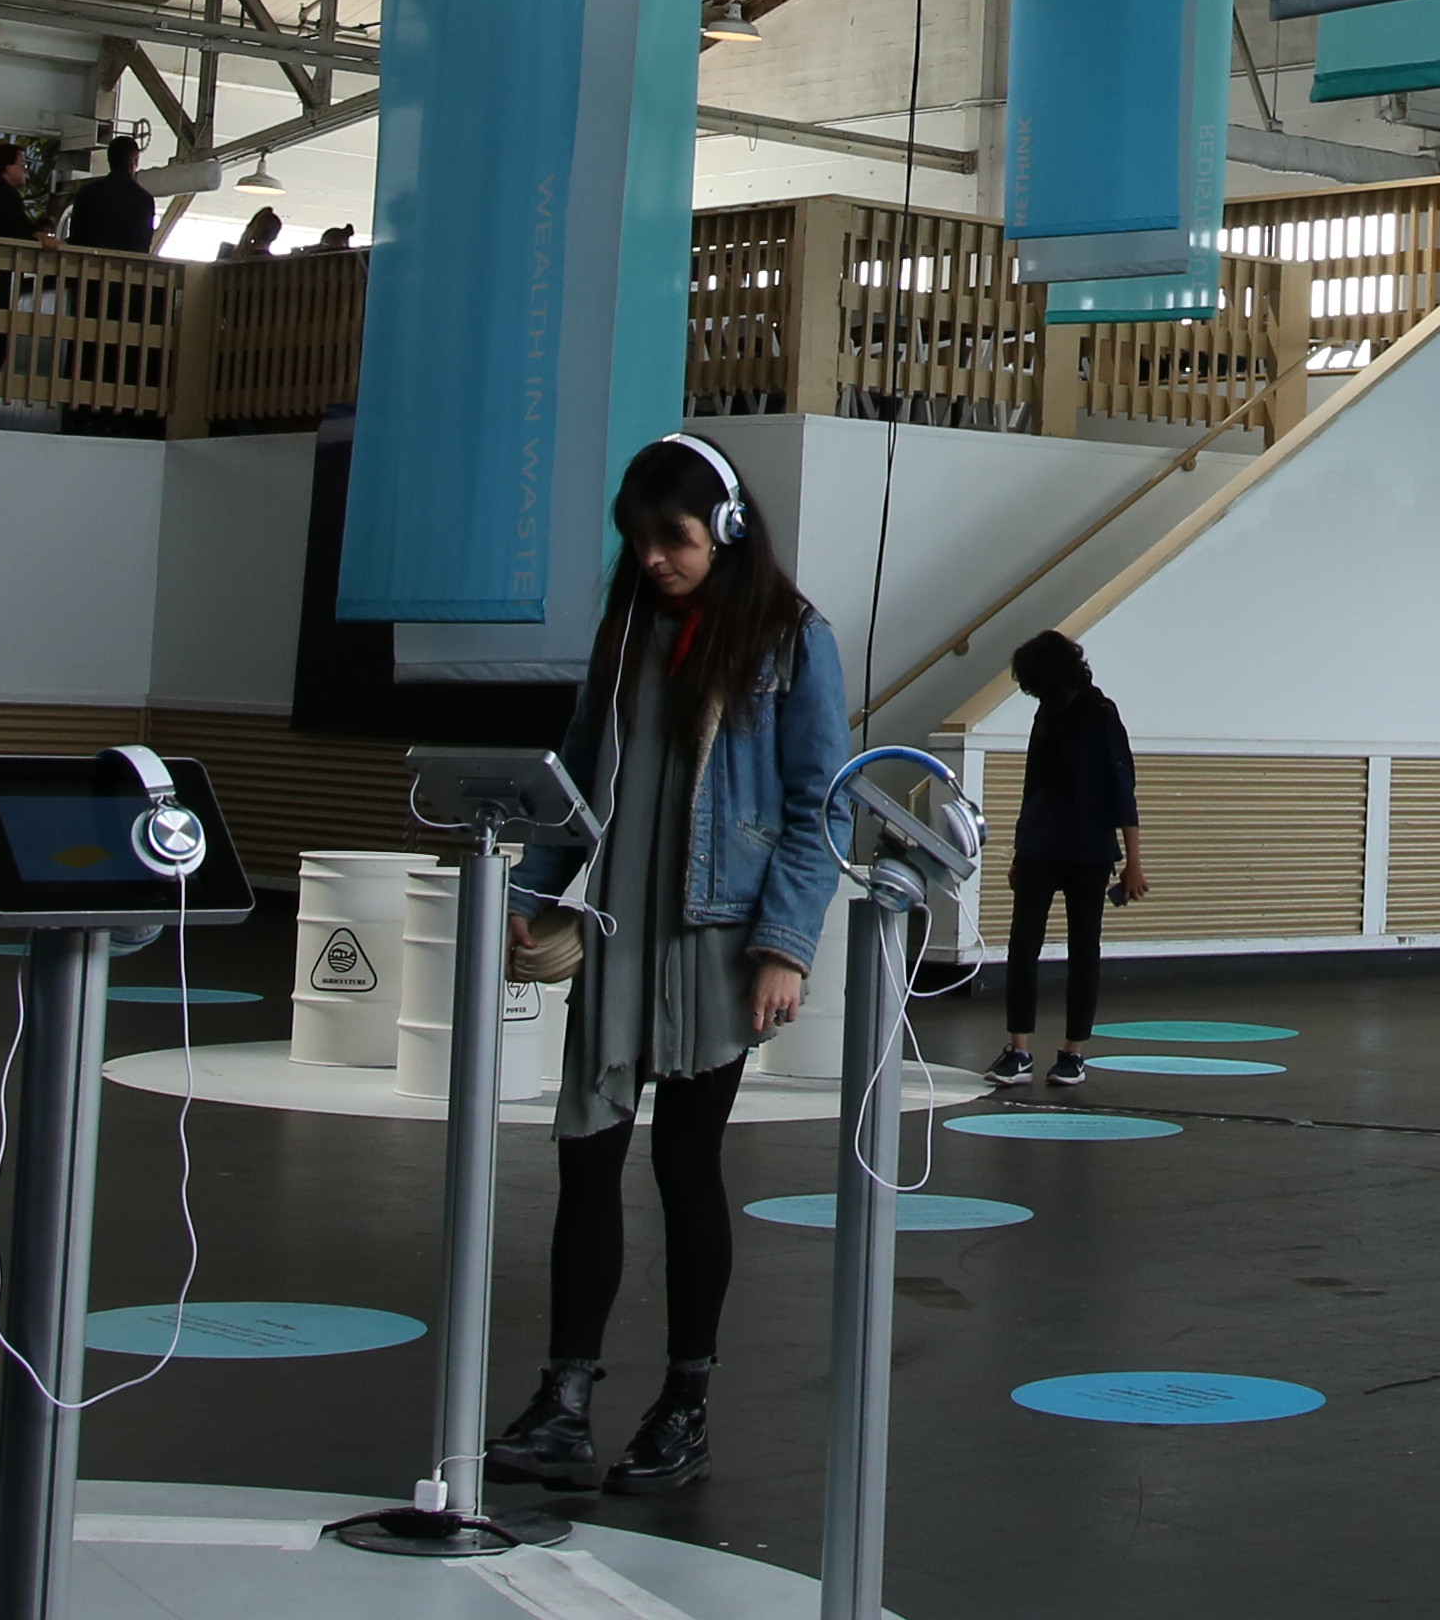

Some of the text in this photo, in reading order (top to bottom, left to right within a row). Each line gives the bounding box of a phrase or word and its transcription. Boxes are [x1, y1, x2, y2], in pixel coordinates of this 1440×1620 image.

[1014, 116, 1033, 227] RETHINK
[527, 175, 556, 358] WEALTH
[522, 377, 544, 422] IN
[322, 977, 367, 985] AGRICULTURE
